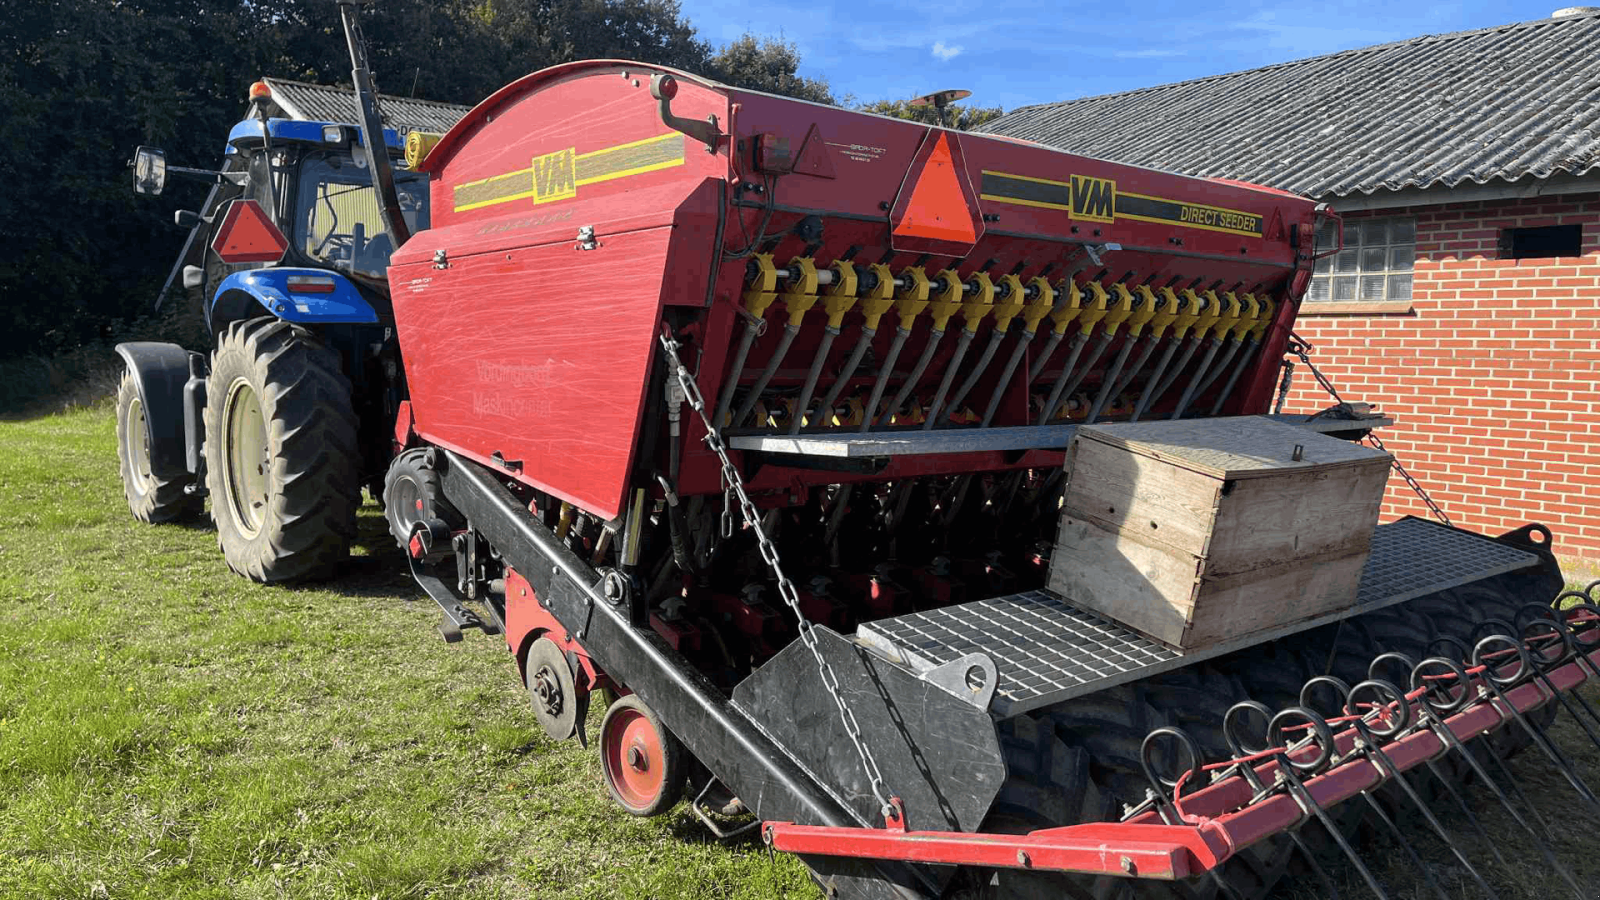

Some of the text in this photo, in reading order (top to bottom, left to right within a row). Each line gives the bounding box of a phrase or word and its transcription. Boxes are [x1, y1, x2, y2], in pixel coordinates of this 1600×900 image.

[534, 149, 575, 197] VM
[1071, 176, 1113, 218] VM
[1180, 206, 1256, 232] DIRECT SEEDER
